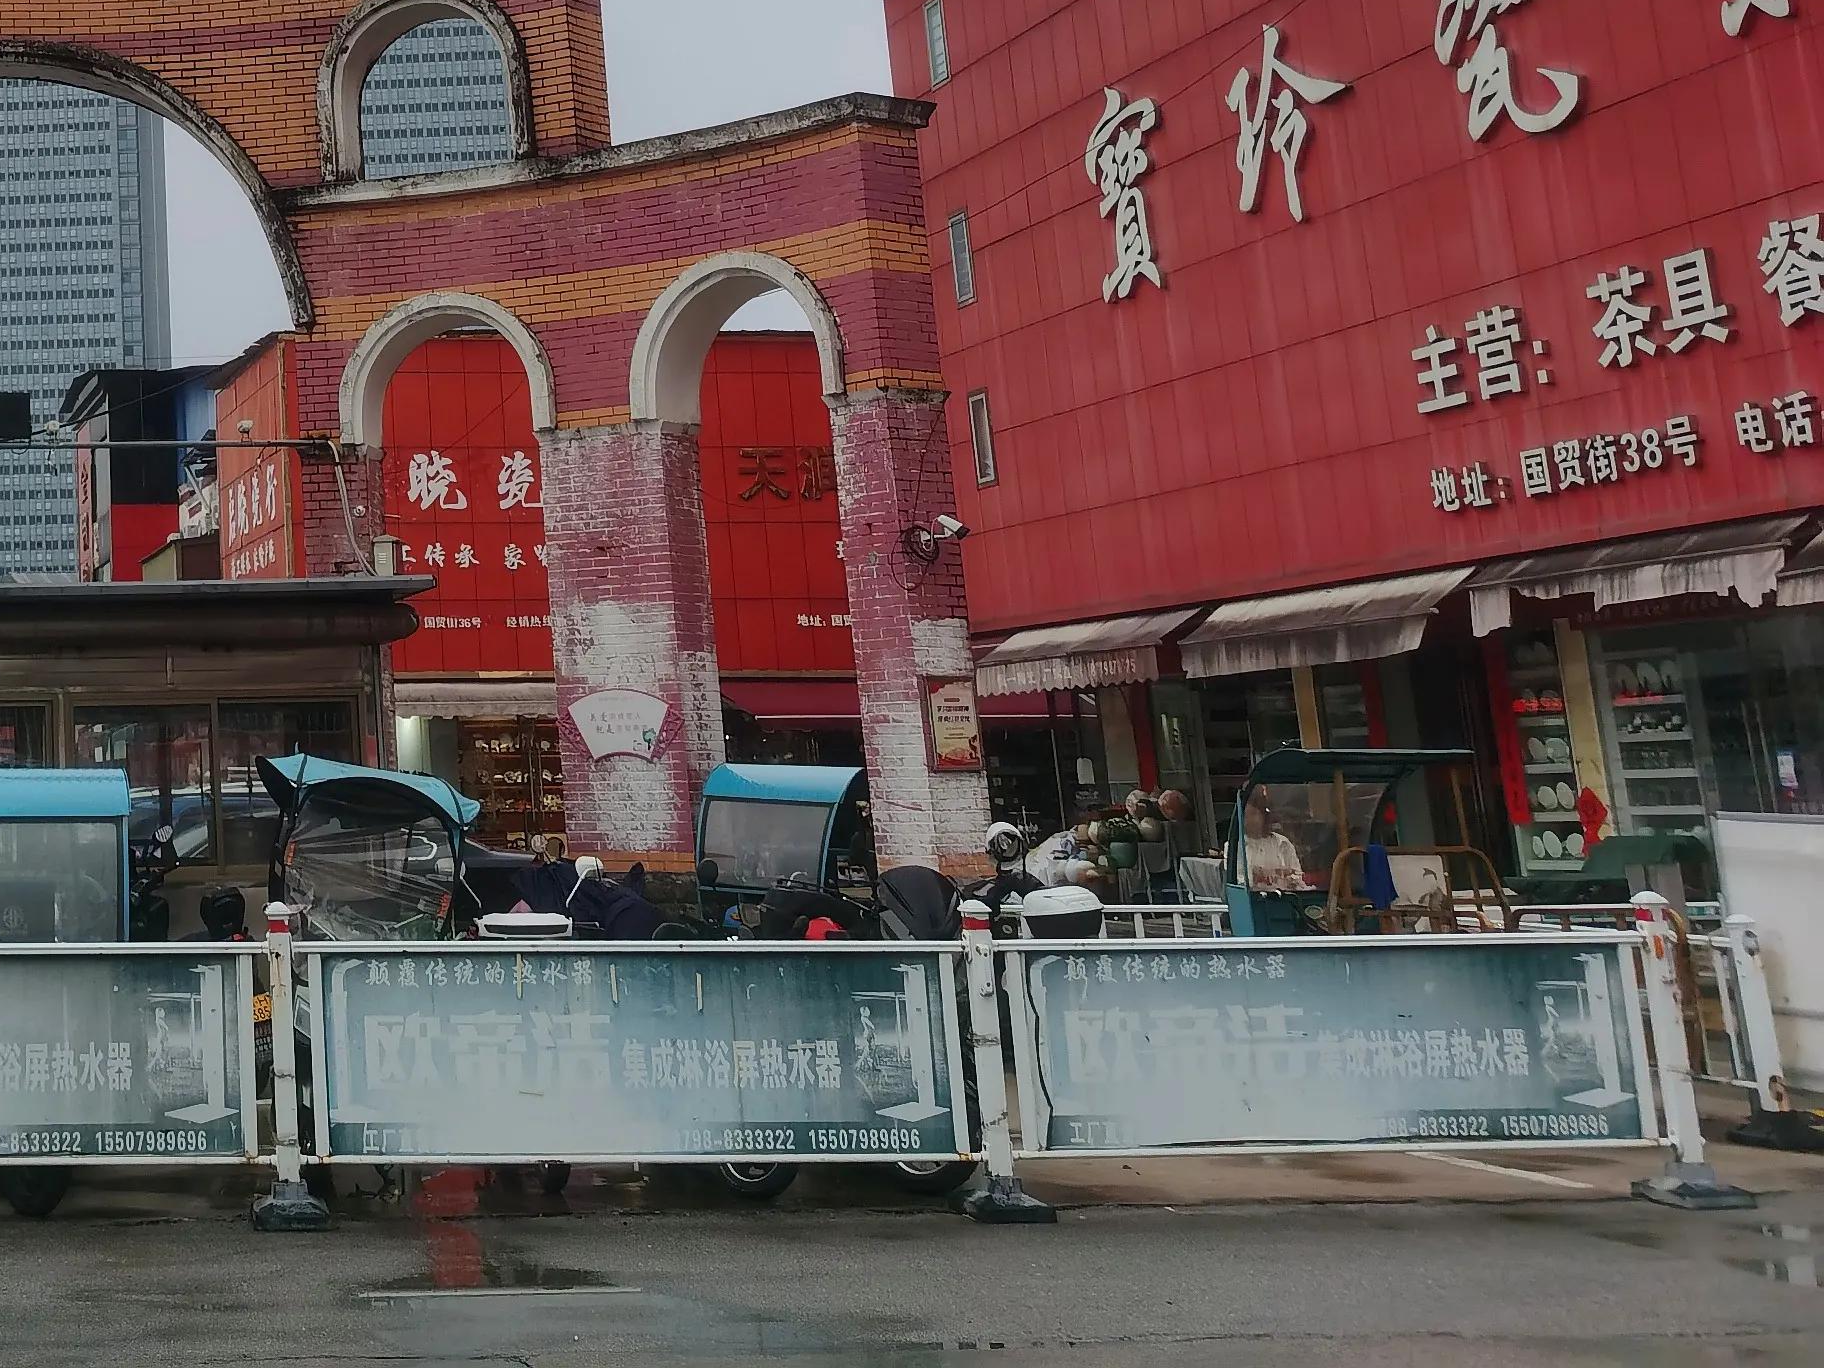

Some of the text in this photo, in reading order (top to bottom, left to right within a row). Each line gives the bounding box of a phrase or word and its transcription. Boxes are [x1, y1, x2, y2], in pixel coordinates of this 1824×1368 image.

[1586, 248, 1729, 369] 茶具
[365, 958, 593, 986] 颠覆传统的热水器
[1063, 953, 1287, 983] 颠覆传统的热水器
[1500, 1114, 1609, 1137] 15507989696
[95, 1130, 207, 1152] 15507989696
[808, 1128, 921, 1150] 15507989696
